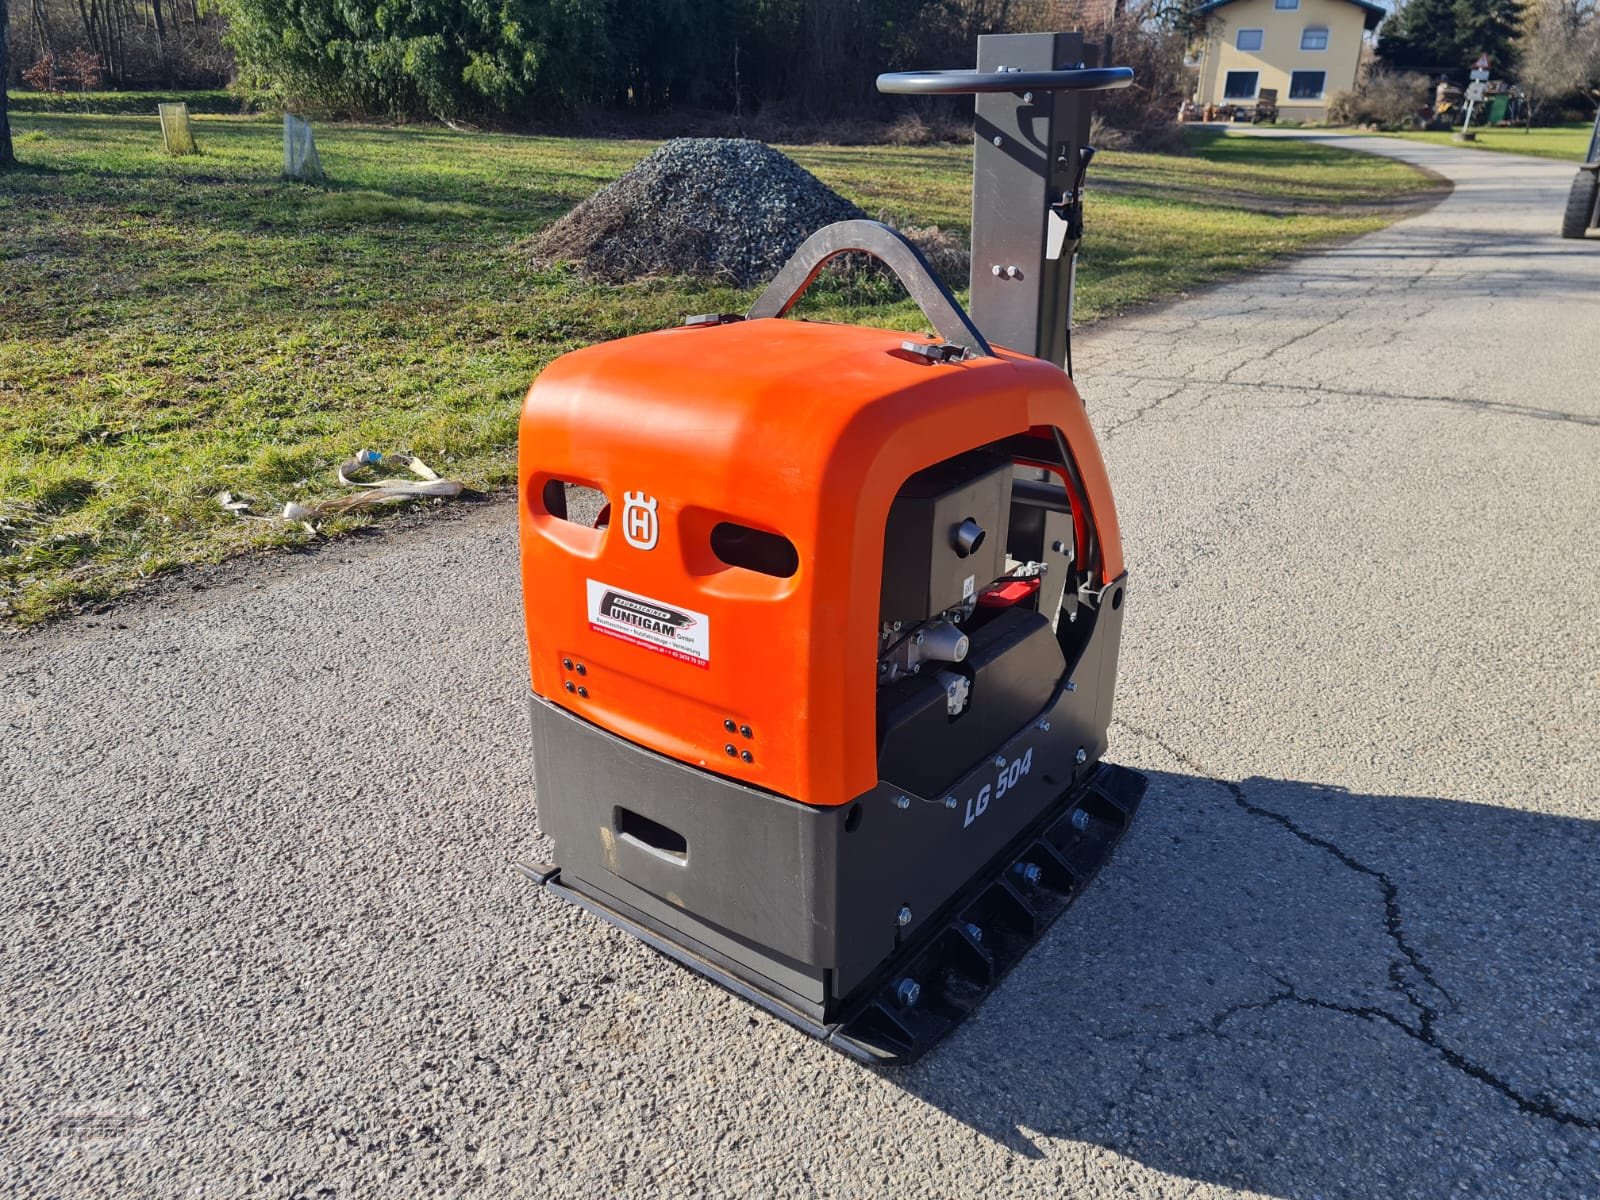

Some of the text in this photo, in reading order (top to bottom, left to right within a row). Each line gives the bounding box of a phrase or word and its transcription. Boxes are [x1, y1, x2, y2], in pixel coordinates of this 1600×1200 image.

[612, 608, 695, 644] UNTIGAM GmbH
[672, 641, 701, 657] Vermietung
[963, 747, 1033, 829] LG 504
